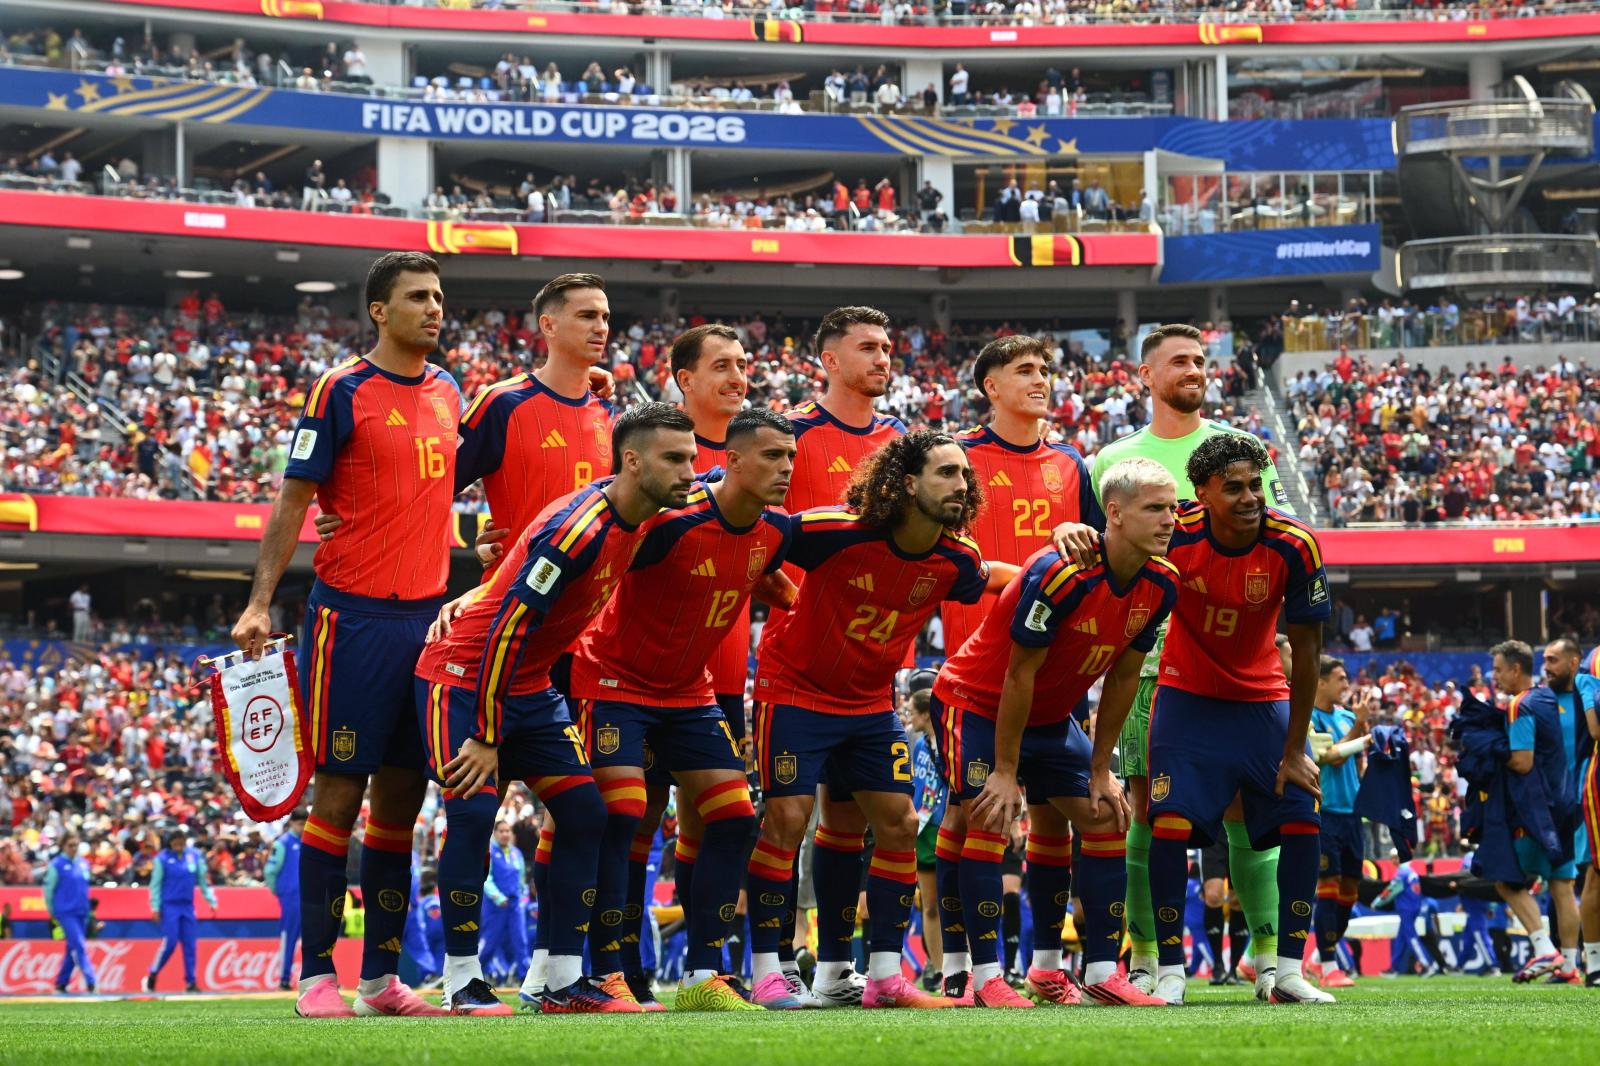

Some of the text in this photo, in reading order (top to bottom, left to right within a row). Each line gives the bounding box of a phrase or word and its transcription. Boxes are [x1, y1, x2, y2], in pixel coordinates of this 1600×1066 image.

[362, 103, 746, 143] FIFA WORLD CUP 2026
[1276, 239, 1371, 259] #FIFAWorldCup
[415, 437, 446, 479] 16
[574, 461, 592, 490] 8
[1012, 498, 1051, 537] 22
[704, 590, 740, 628] 12
[845, 604, 899, 643] 24
[1203, 605, 1239, 637] 19
[1077, 645, 1116, 675] 10
[563, 724, 590, 766] 1
[718, 720, 742, 758] 1
[891, 741, 914, 781] 2
